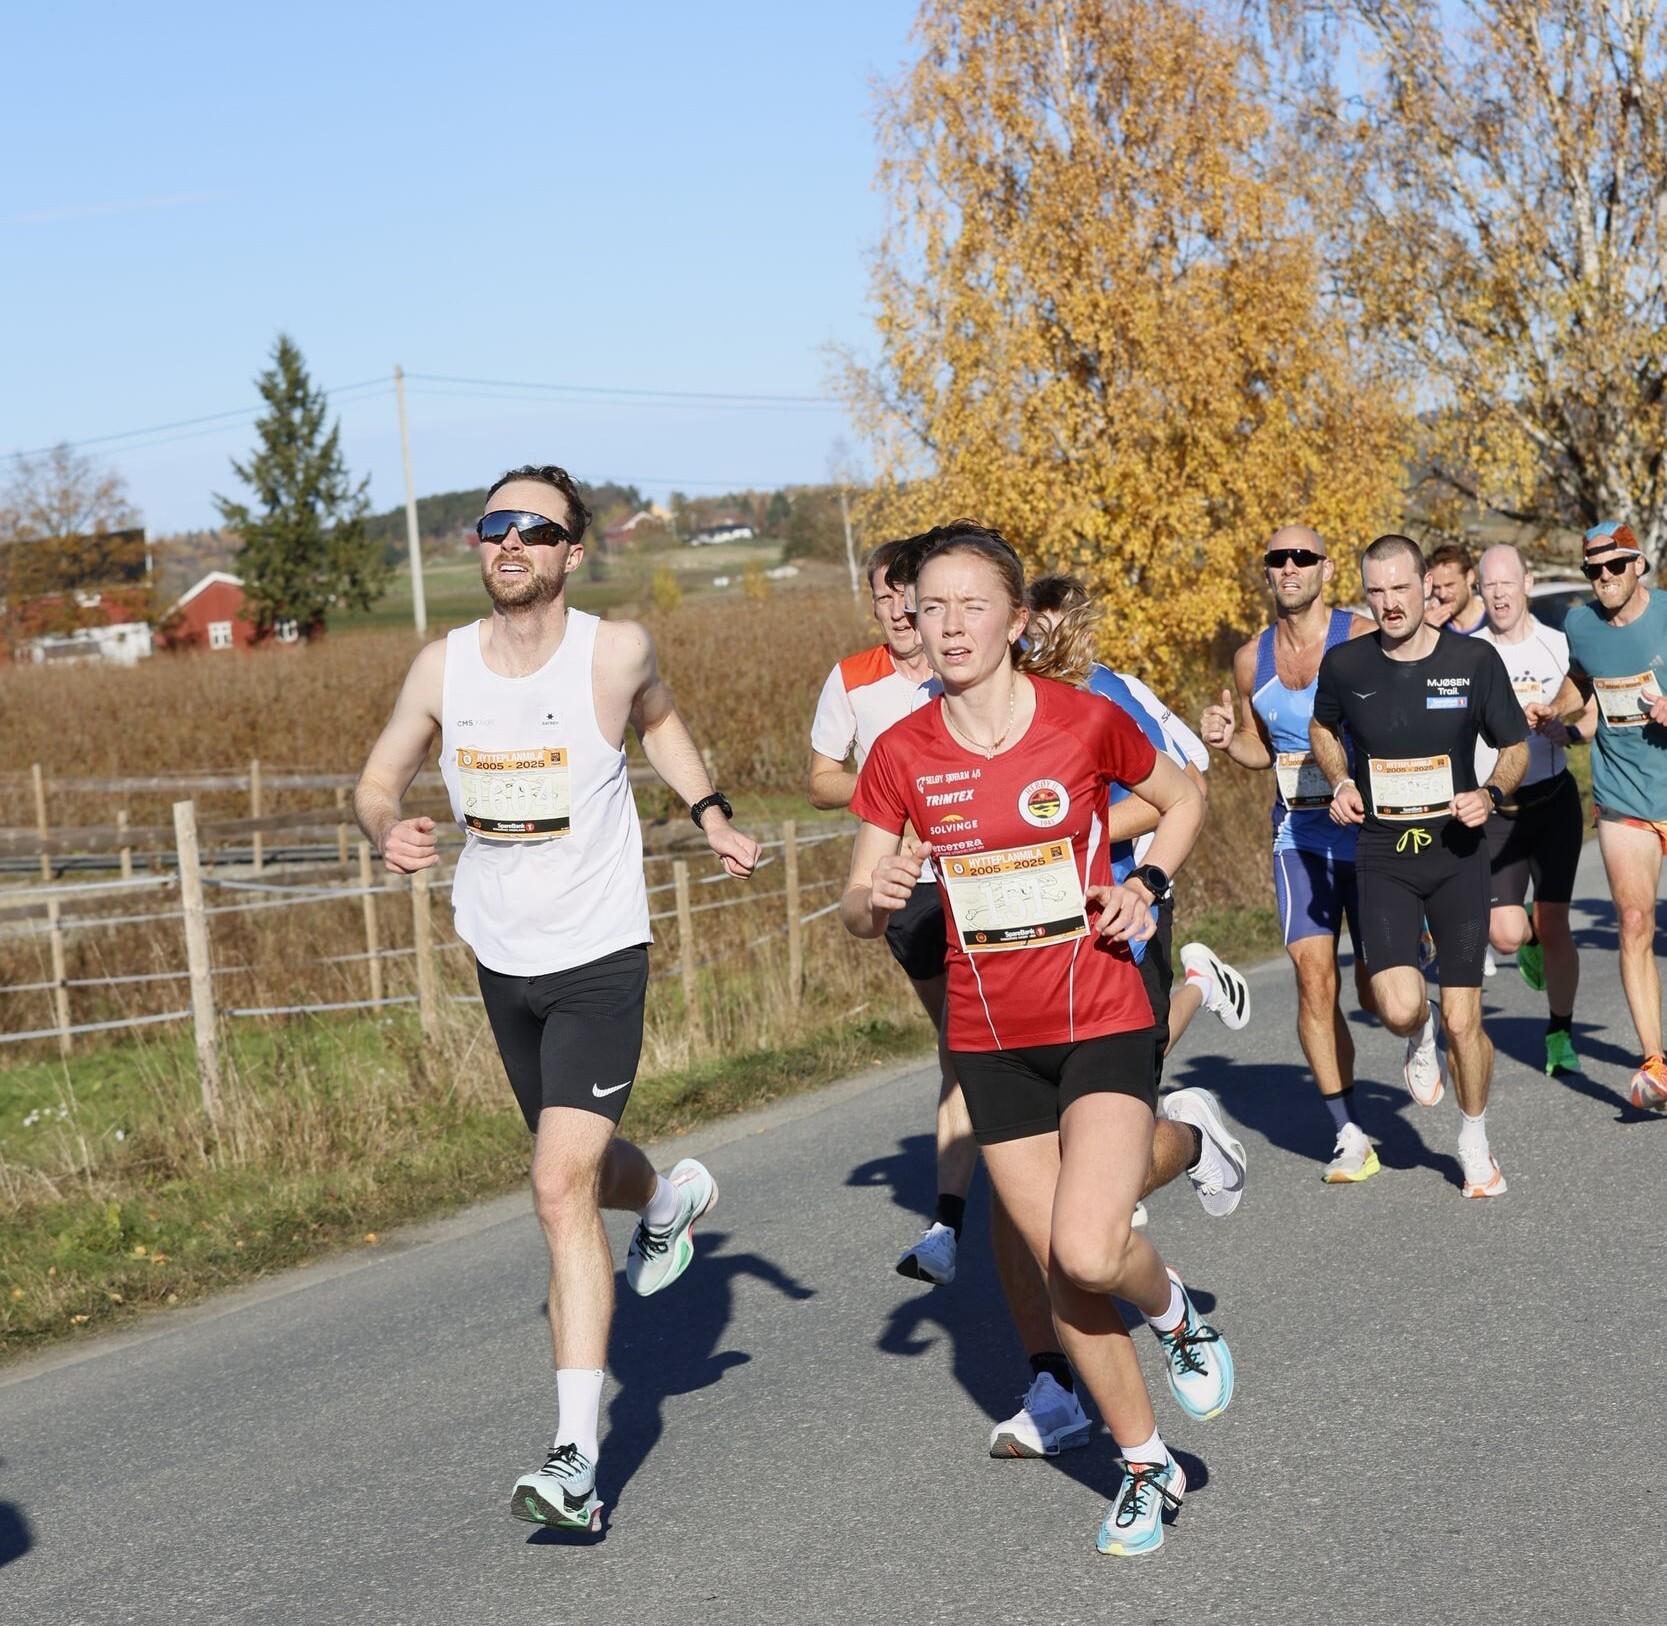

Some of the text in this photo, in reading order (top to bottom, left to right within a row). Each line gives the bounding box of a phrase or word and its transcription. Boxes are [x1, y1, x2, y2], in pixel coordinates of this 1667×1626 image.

[1427, 678, 1470, 687] MJØSEN
[1438, 687, 1460, 695] Trail.
[477, 751, 544, 763] HYTTEPLANMILA
[476, 761, 504, 771] 2005
[516, 760, 545, 769] 2025
[1025, 780, 1051, 795] HERØY
[926, 789, 975, 807] TRIMTEX
[930, 820, 978, 835] SOLVINGE
[968, 849, 1043, 867] HYTTEPLANMILA
[970, 865, 1001, 876] 2005
[1014, 857, 1046, 869] 2025
[979, 877, 1049, 925] 151
[1004, 928, 1035, 937] SpareBank
